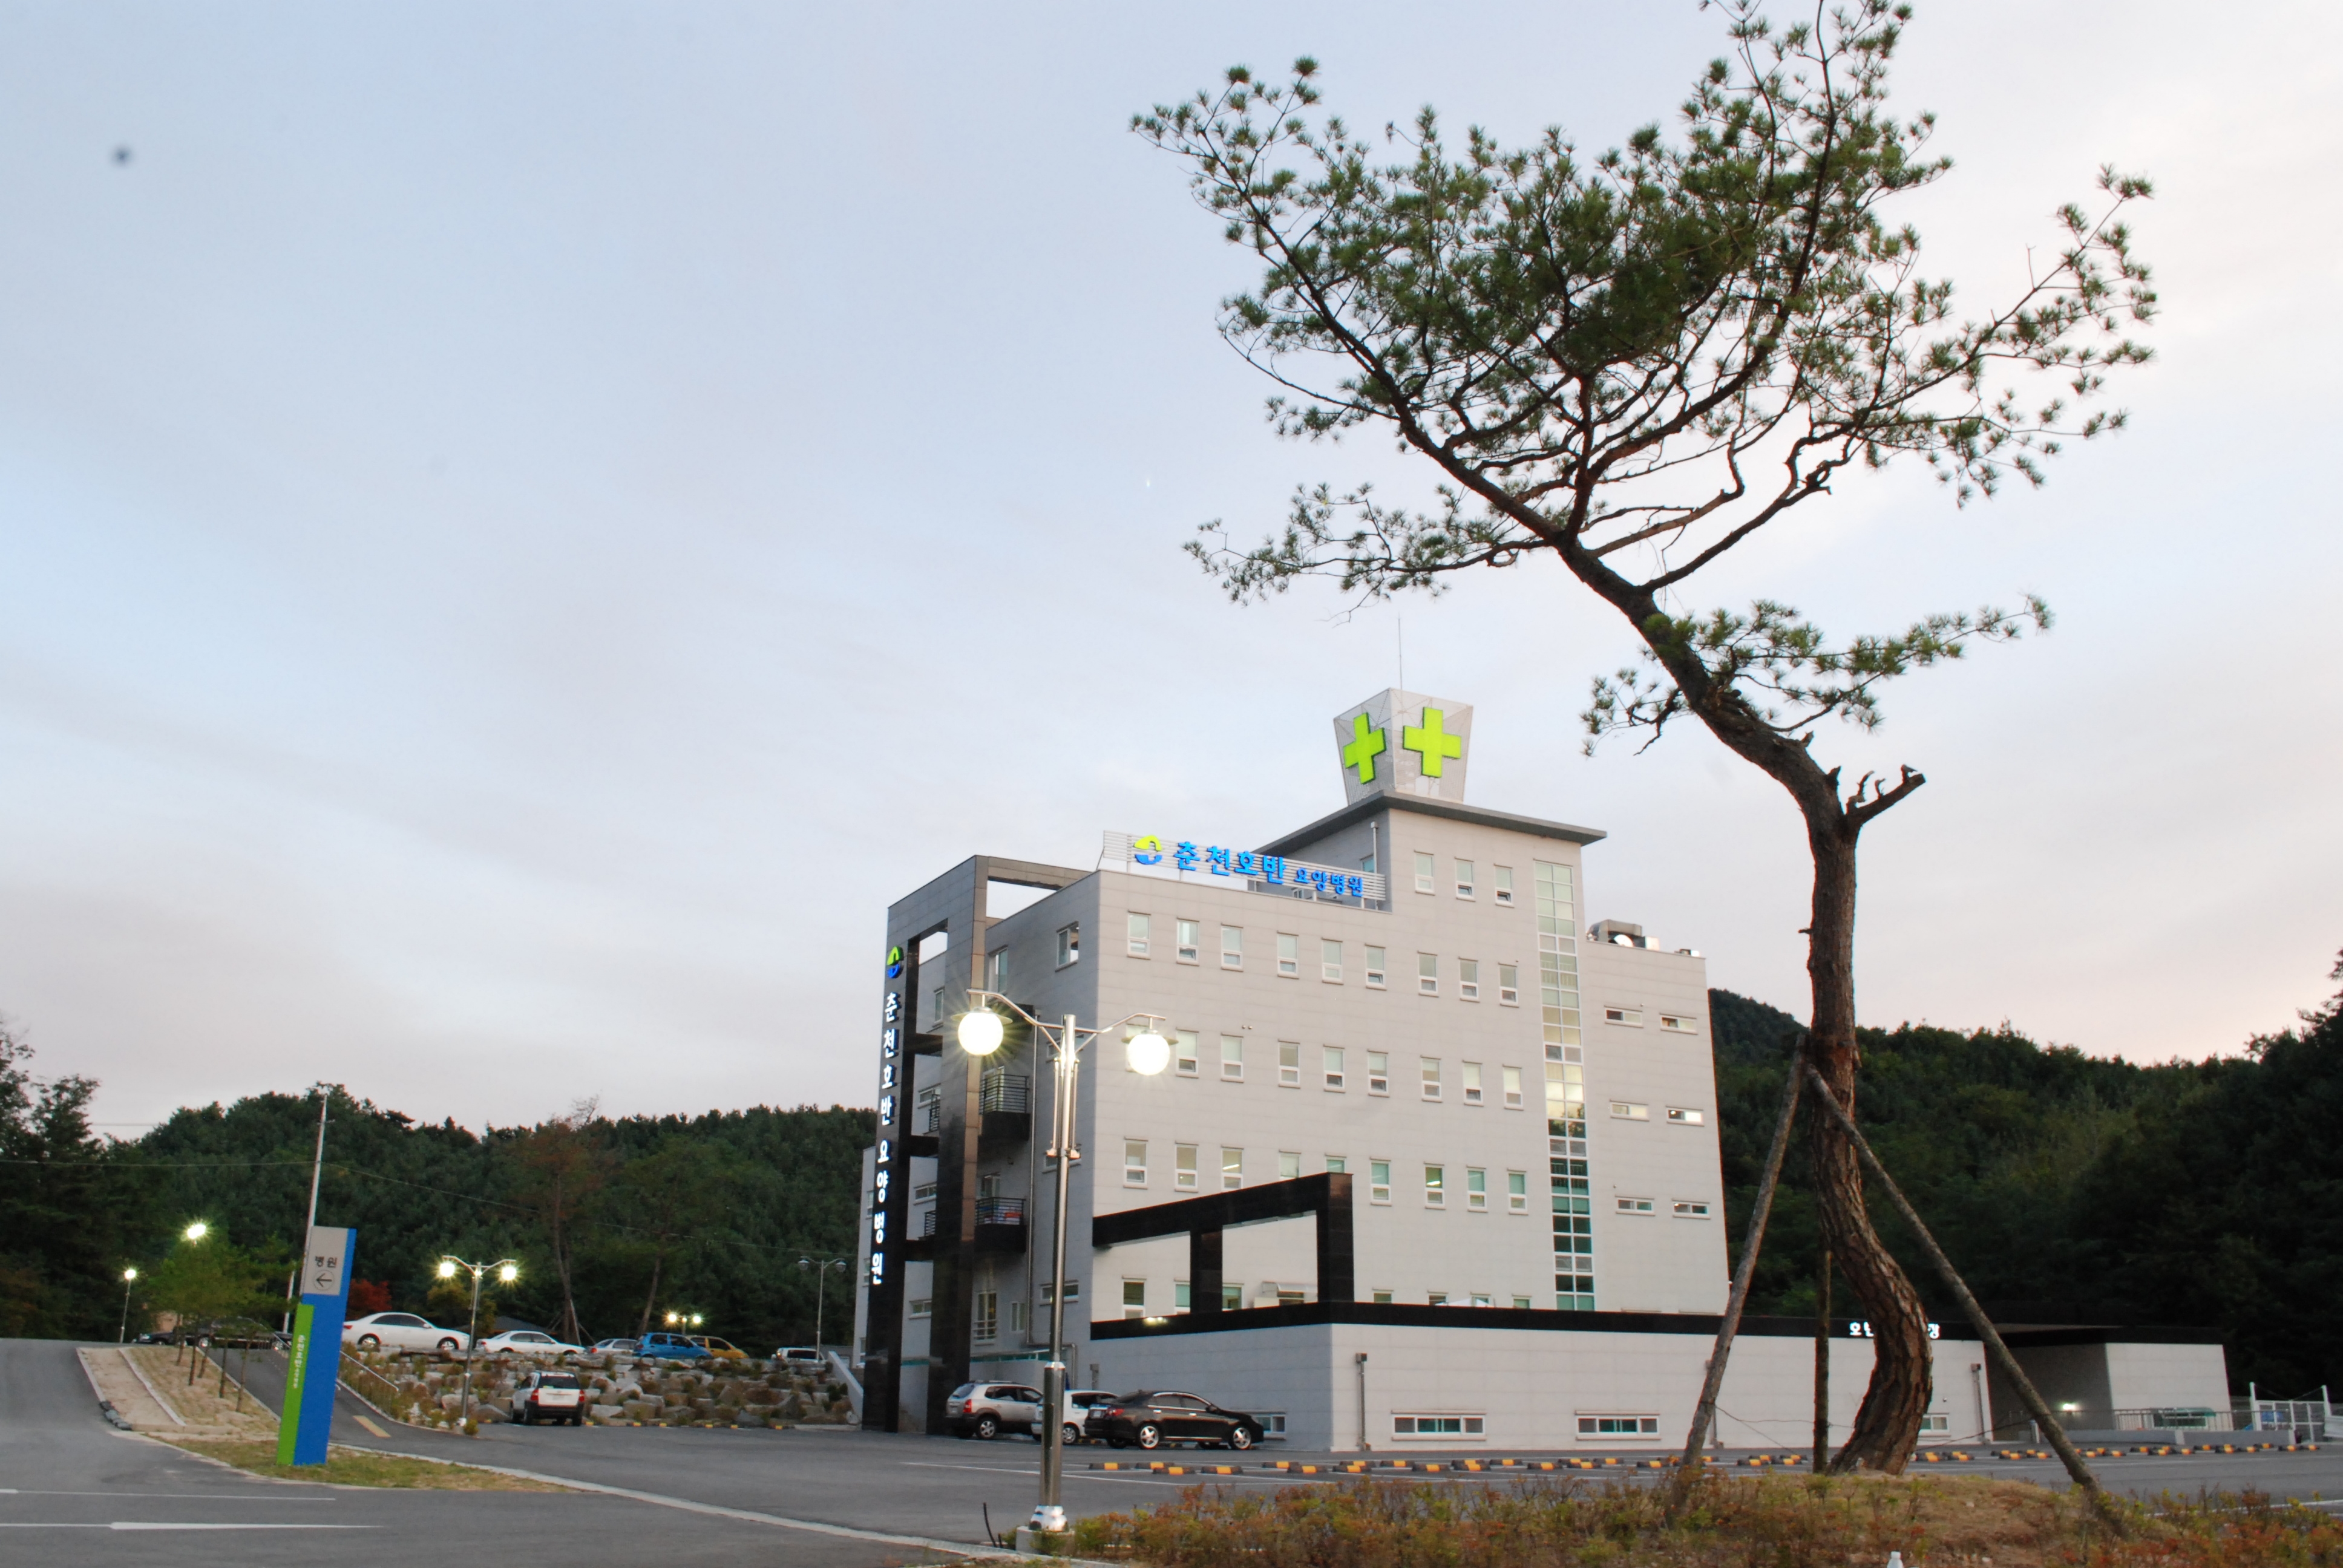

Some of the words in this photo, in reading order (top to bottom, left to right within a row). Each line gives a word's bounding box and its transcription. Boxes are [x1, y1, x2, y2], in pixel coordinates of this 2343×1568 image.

[1174, 841, 1287, 885] 춘천호반
[1294, 867, 1364, 897] 요양병원
[880, 992, 899, 1126] 춘천호반
[871, 1140, 890, 1285] 요양병원
